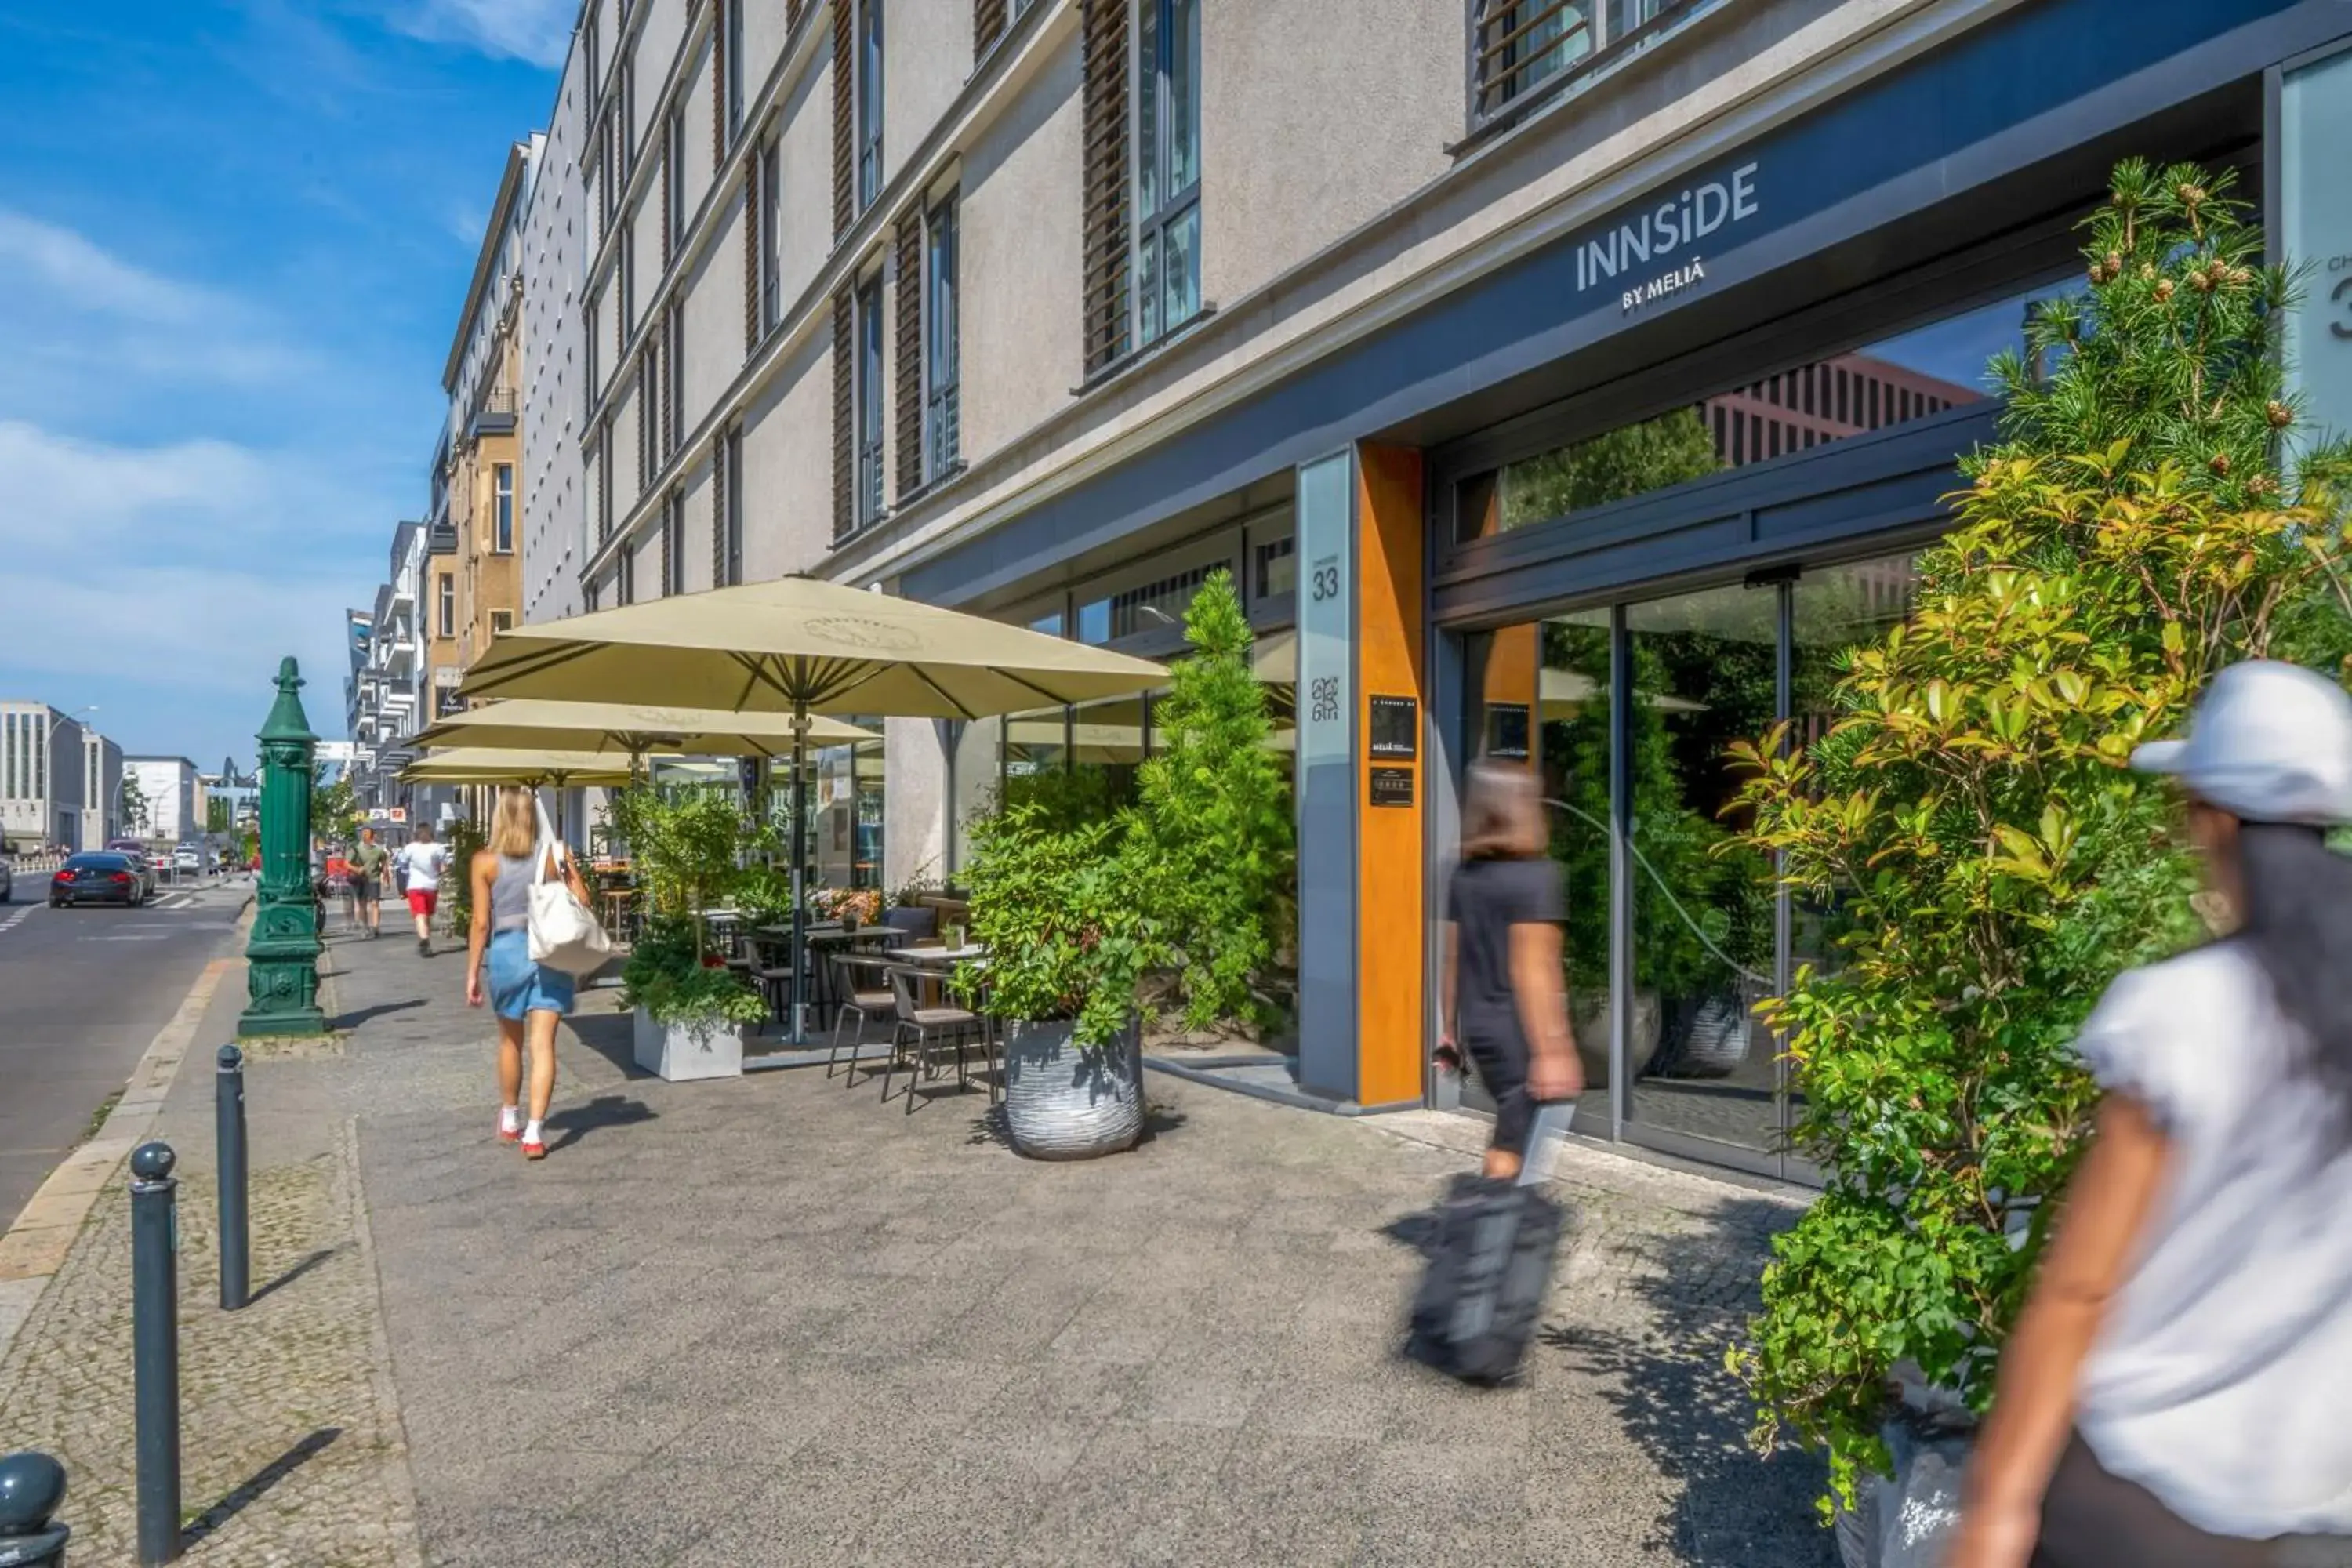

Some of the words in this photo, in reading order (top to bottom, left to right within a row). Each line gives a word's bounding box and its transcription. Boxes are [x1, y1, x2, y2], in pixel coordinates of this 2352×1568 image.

[1577, 161, 1759, 292] INNSiDE
[1623, 285, 1643, 310] BY
[1312, 566, 1338, 601] 33
